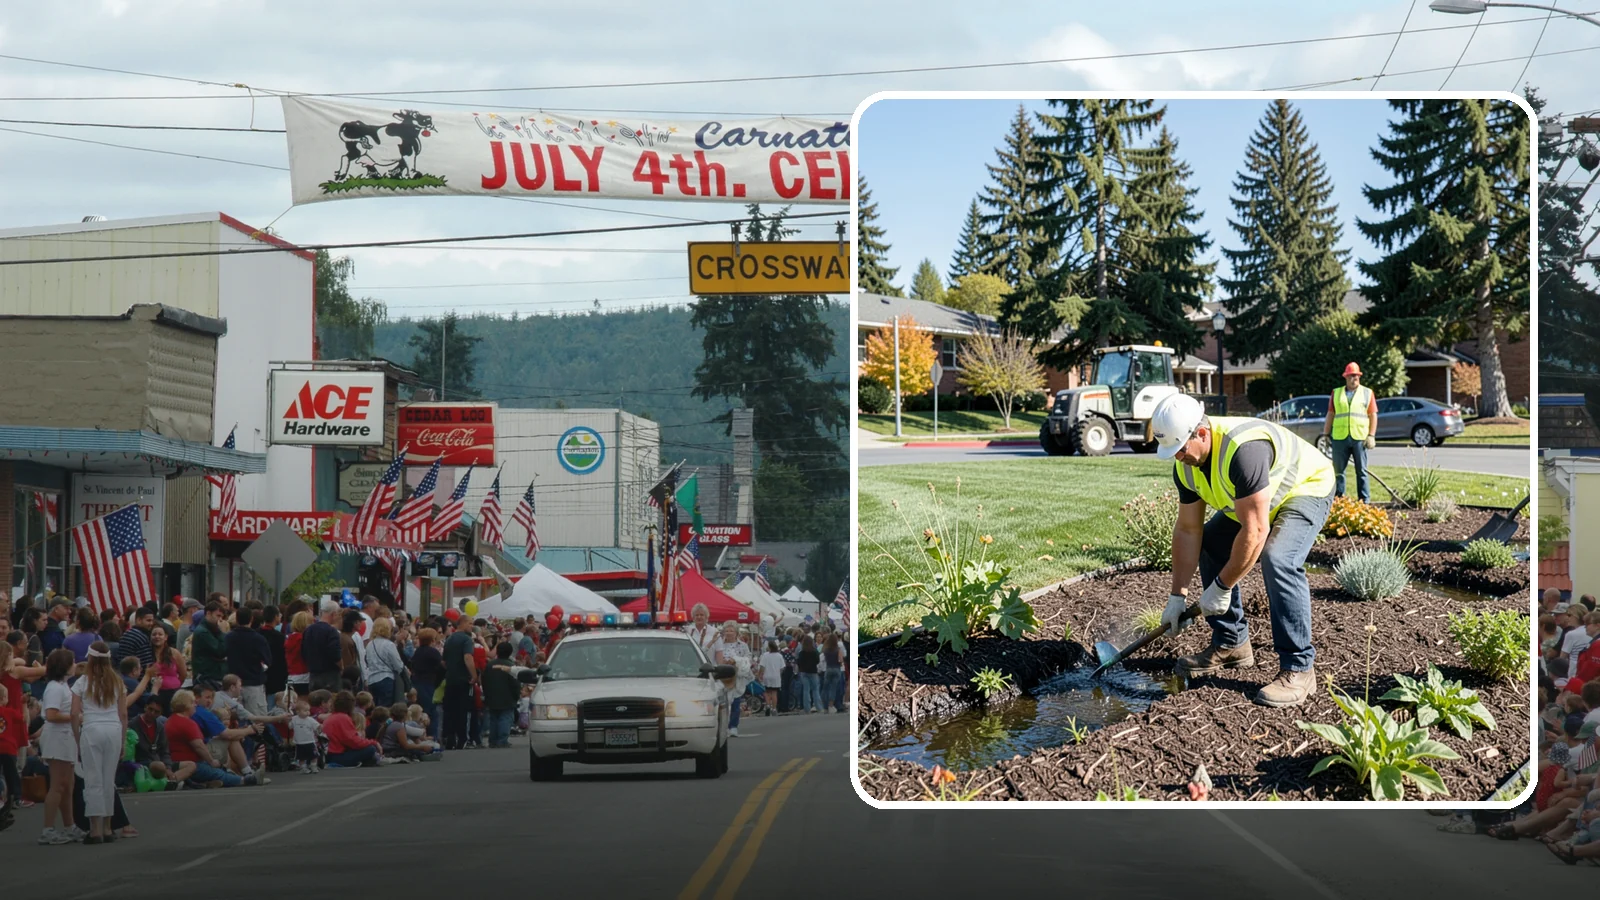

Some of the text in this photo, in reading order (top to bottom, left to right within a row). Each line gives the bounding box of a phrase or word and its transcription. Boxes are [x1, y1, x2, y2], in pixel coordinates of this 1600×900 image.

[481, 141, 605, 192] JULY
[632, 150, 746, 198] 4th.
[697, 254, 850, 280] CROSSWA
[283, 380, 373, 420] ACE
[405, 410, 452, 422] CEDAR
[283, 421, 371, 436] Hardware
[416, 428, 477, 447] Coca-Cola
[96, 485, 124, 495] Vincent
[126, 486, 136, 495] de
[138, 486, 155, 496] Paul
[688, 526, 741, 535] CRNATION
[699, 535, 730, 543] GLASS
